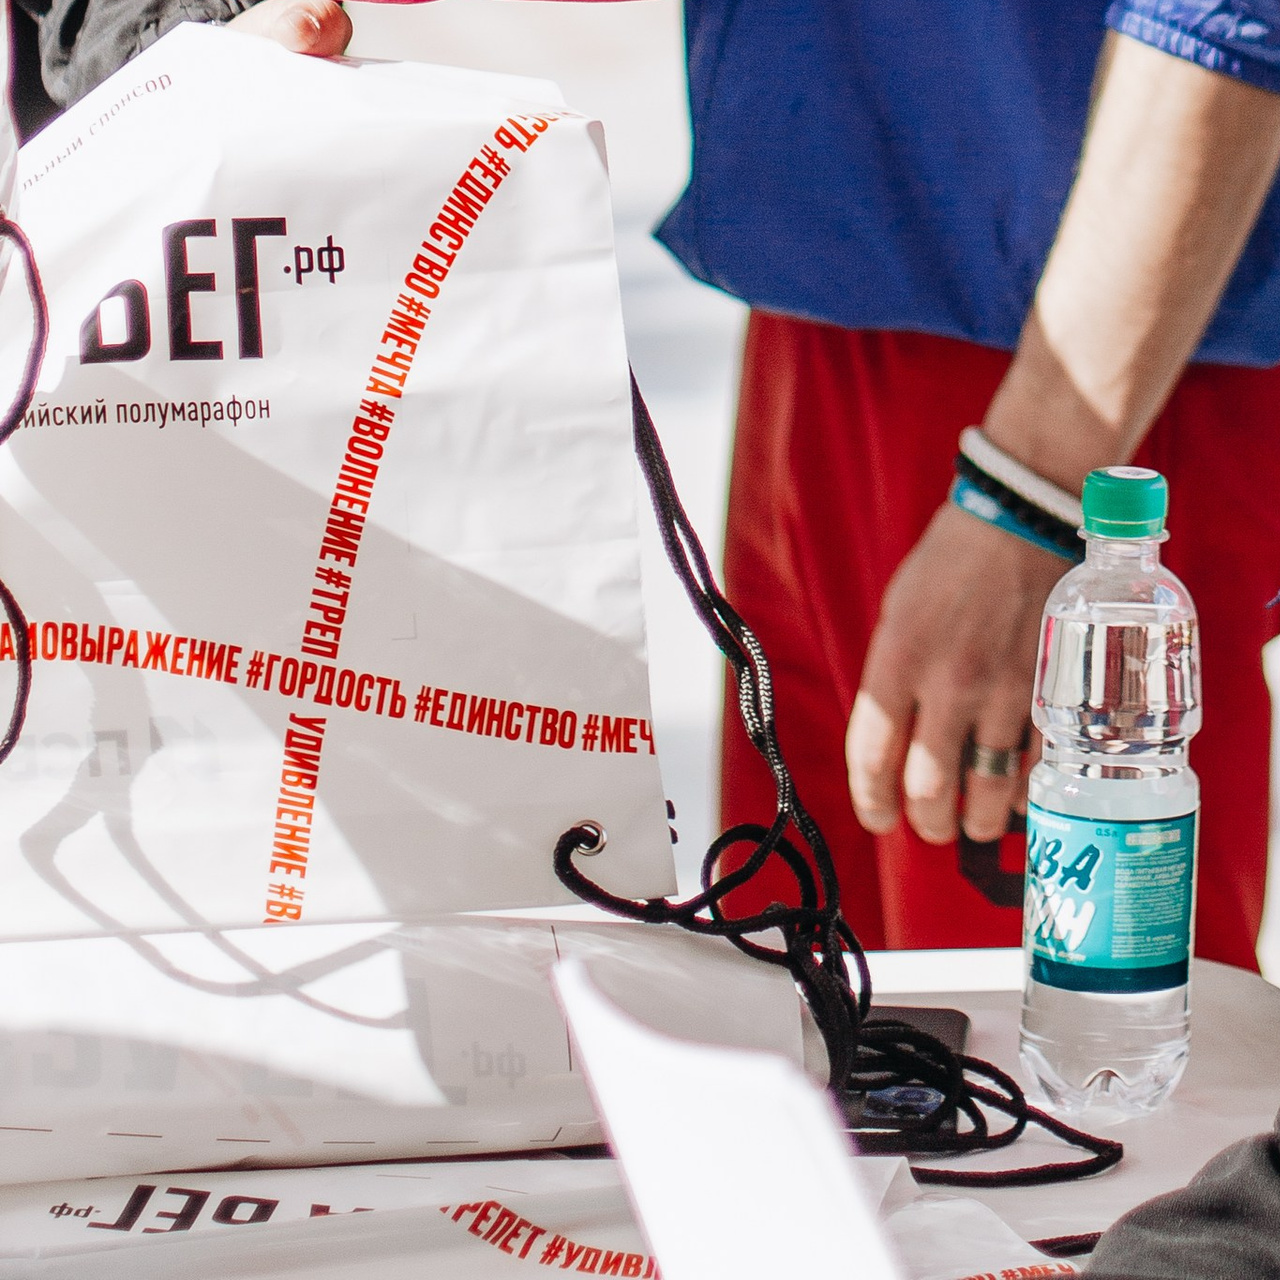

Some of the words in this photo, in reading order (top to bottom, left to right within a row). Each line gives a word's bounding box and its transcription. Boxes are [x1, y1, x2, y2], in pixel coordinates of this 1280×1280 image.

[405, 144, 511, 299] #ЕДИНСТВО
[366, 293, 431, 398] #МЕЧТА
[18, 398, 107, 428] ийский
[117, 395, 270, 429] полумарафон
[319, 399, 395, 567] #ВОЛНЕНИЕ
[301, 566, 352, 660] #ТРЕП
[246, 650, 406, 718] #ГОРДОСТЬ
[414, 685, 577, 749] #ЕДИНСТВО
[582, 713, 656, 755] #МЕЧ
[269, 713, 326, 879] УДИВЛЕНИЕ
[263, 883, 304, 924] #В
[439, 1200, 547, 1260] РЕПЕТ
